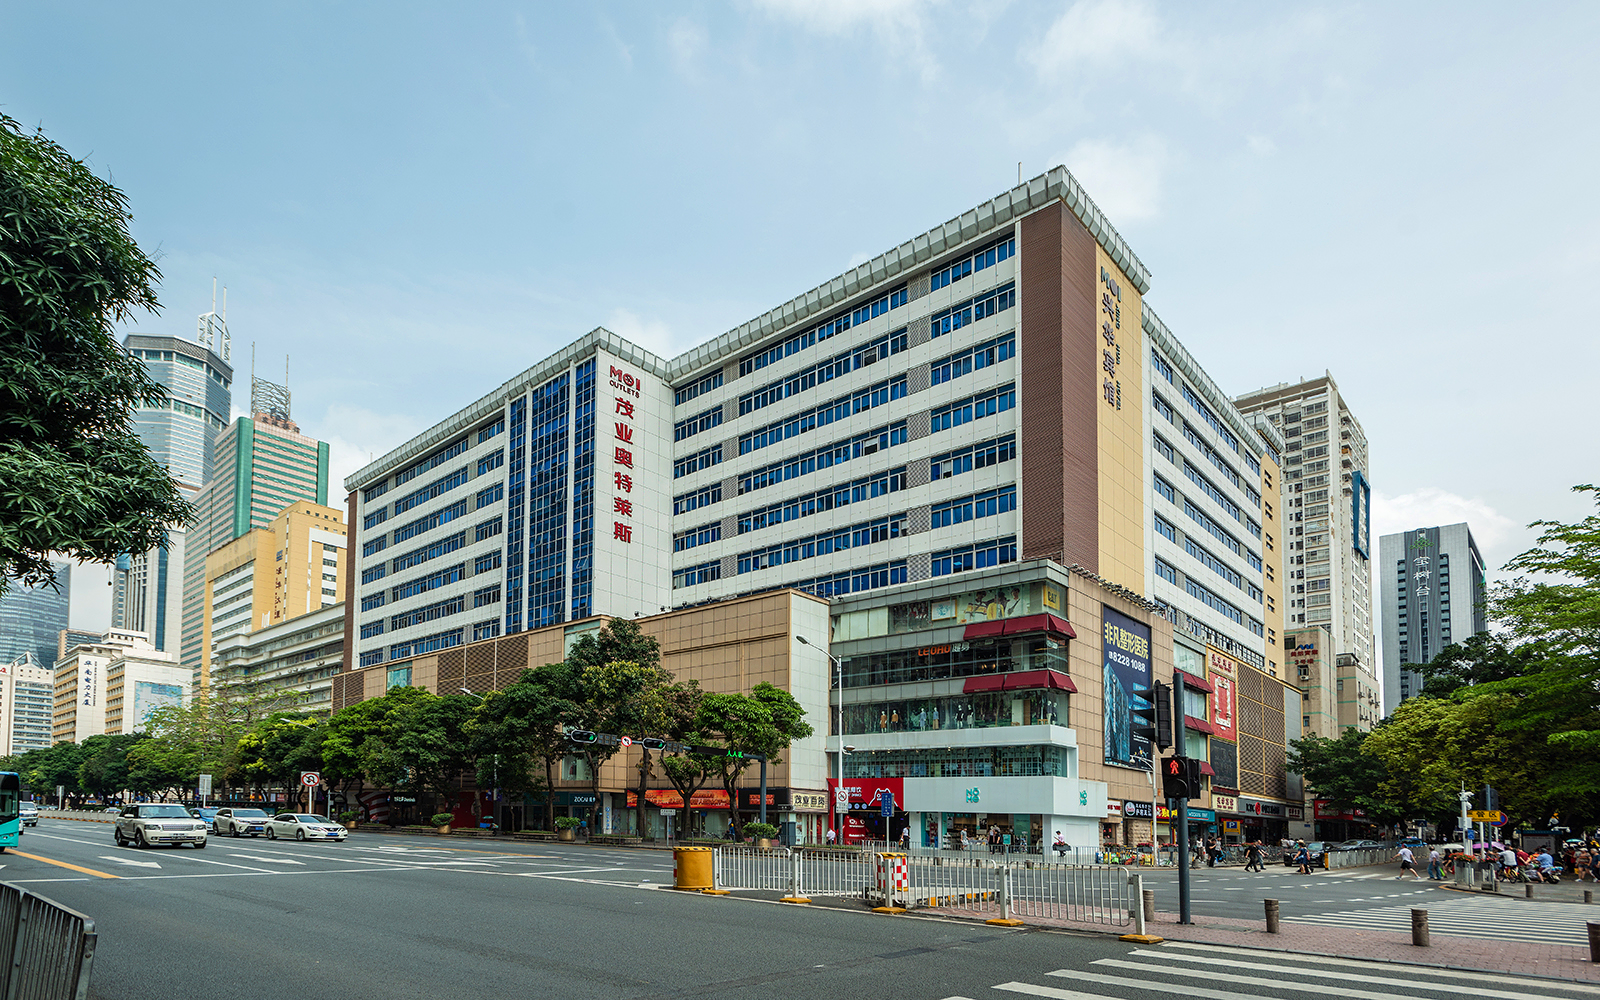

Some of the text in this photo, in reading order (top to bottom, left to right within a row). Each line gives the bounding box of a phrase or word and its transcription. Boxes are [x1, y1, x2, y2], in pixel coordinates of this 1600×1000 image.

[1102, 292, 1116, 407] 兴华宾馆
[609, 379, 640, 398] OUTLETS
[613, 397, 635, 543] 茂业奥特莱斯
[1413, 556, 1432, 597] 宝树台
[1048, 591, 1057, 603] CAT
[1104, 621, 1149, 659] 非凡整形医院
[1113, 651, 1146, 673] 8228 1088
[794, 794, 825, 805] 茂业百货
